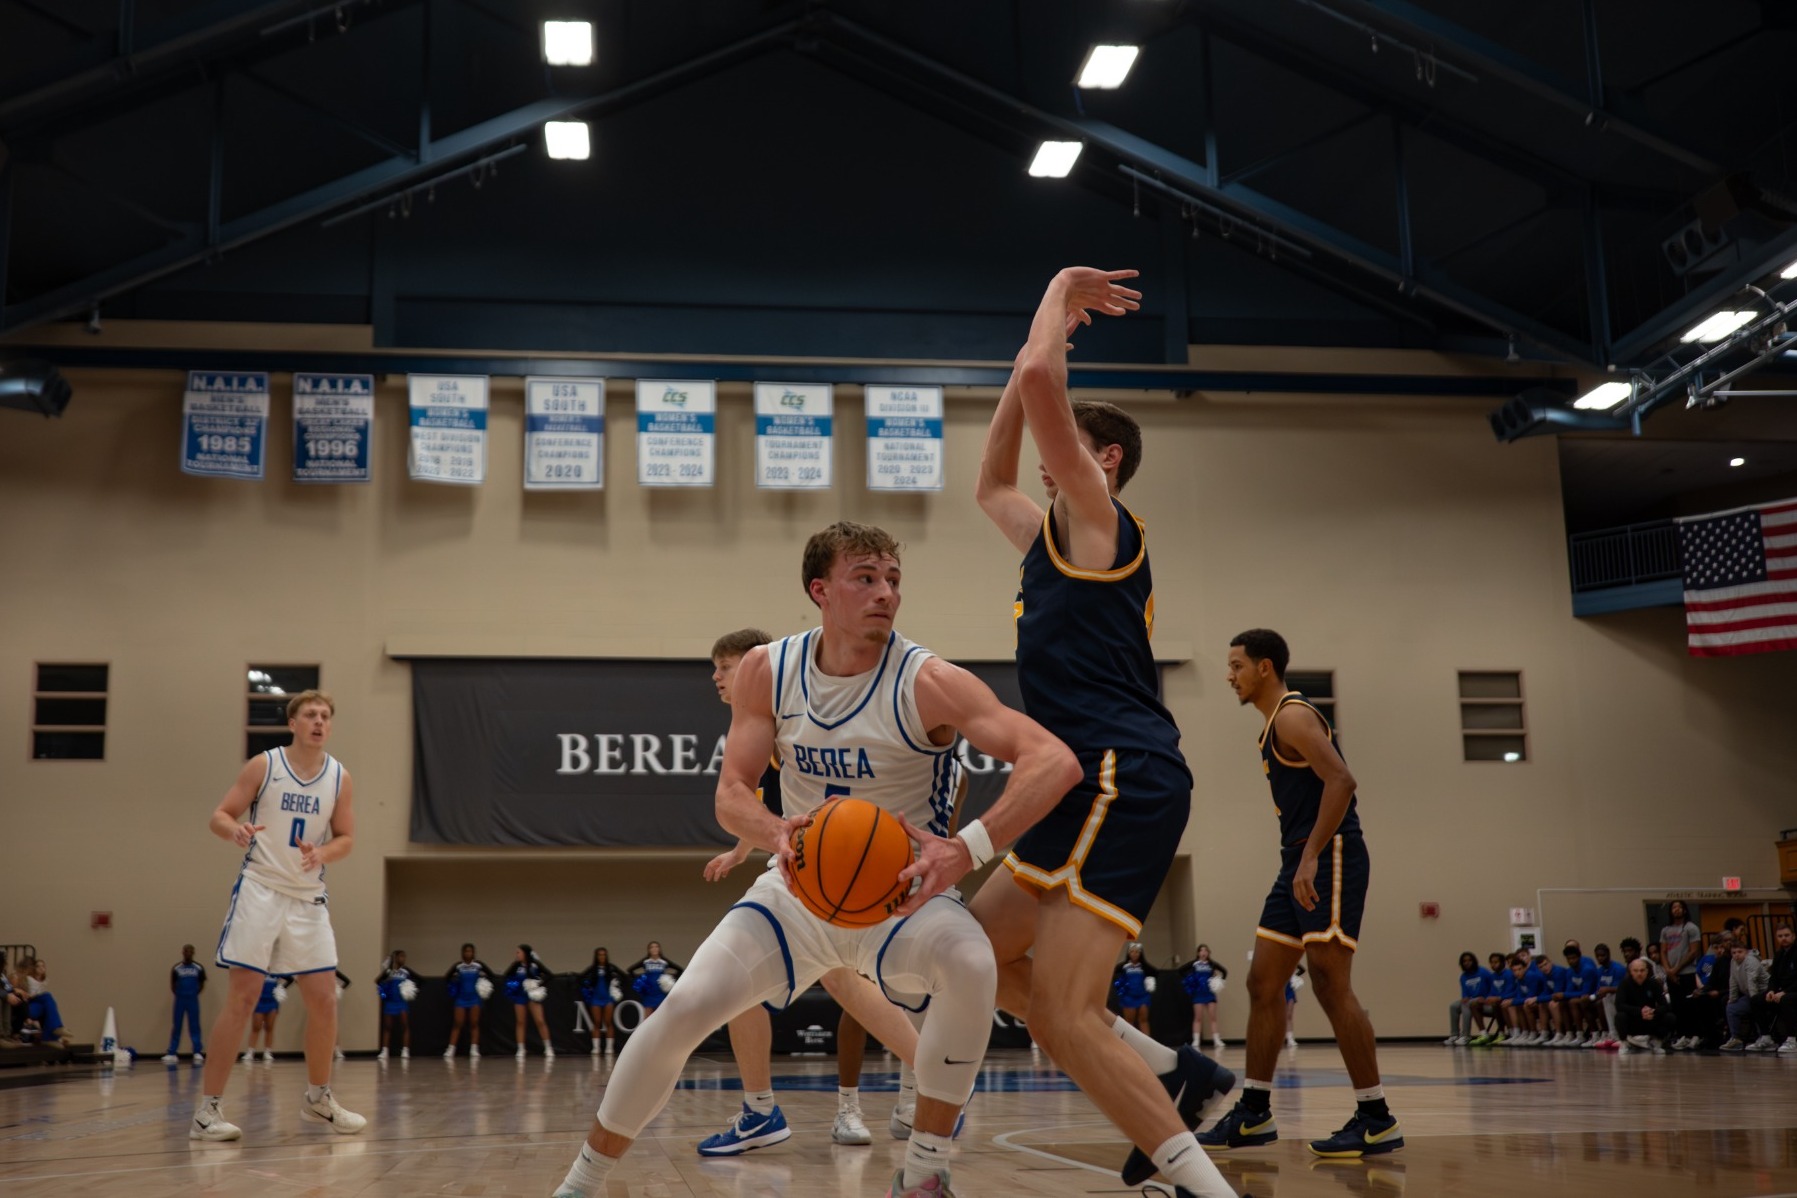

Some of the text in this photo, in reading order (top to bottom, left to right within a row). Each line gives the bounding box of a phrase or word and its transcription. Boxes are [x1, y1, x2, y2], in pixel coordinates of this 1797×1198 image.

[193, 376, 263, 391] N.A.I.A.
[299, 378, 369, 393] N.A.I.A.
[437, 380, 458, 391] USA
[552, 384, 578, 397] USA
[890, 391, 918, 401] NCAA
[430, 393, 466, 403] SOUTH
[662, 391, 688, 403] CCS
[780, 395, 806, 406] CCS
[543, 398, 586, 412] SOUTH
[879, 403, 917, 412] DIVISION
[419, 417, 476, 428] BASKETBALL
[647, 422, 704, 432] BASKETBALL
[766, 425, 822, 436] BASKETBALL
[878, 427, 932, 437] BASKETBALL
[198, 434, 251, 452] 1985
[535, 438, 593, 447] CONFERENCE
[646, 437, 704, 446] CONFERENCE
[764, 440, 824, 449] TOURNAMENT
[884, 442, 926, 451] NATIONAL
[305, 440, 358, 457] 1996
[649, 448, 702, 457] CHAMPIONS
[196, 453, 248, 462] NATIONAL
[537, 450, 590, 459] CHAMPIONS
[768, 450, 820, 460] CHAMPIONS
[877, 452, 935, 462] TOURNAMENT
[305, 459, 357, 467] NATIONAL
[545, 464, 583, 478] 2020
[557, 733, 727, 775] BEREA
[793, 743, 876, 779] BEREA
[281, 792, 320, 815] BEREA
[289, 817, 306, 848] 0
